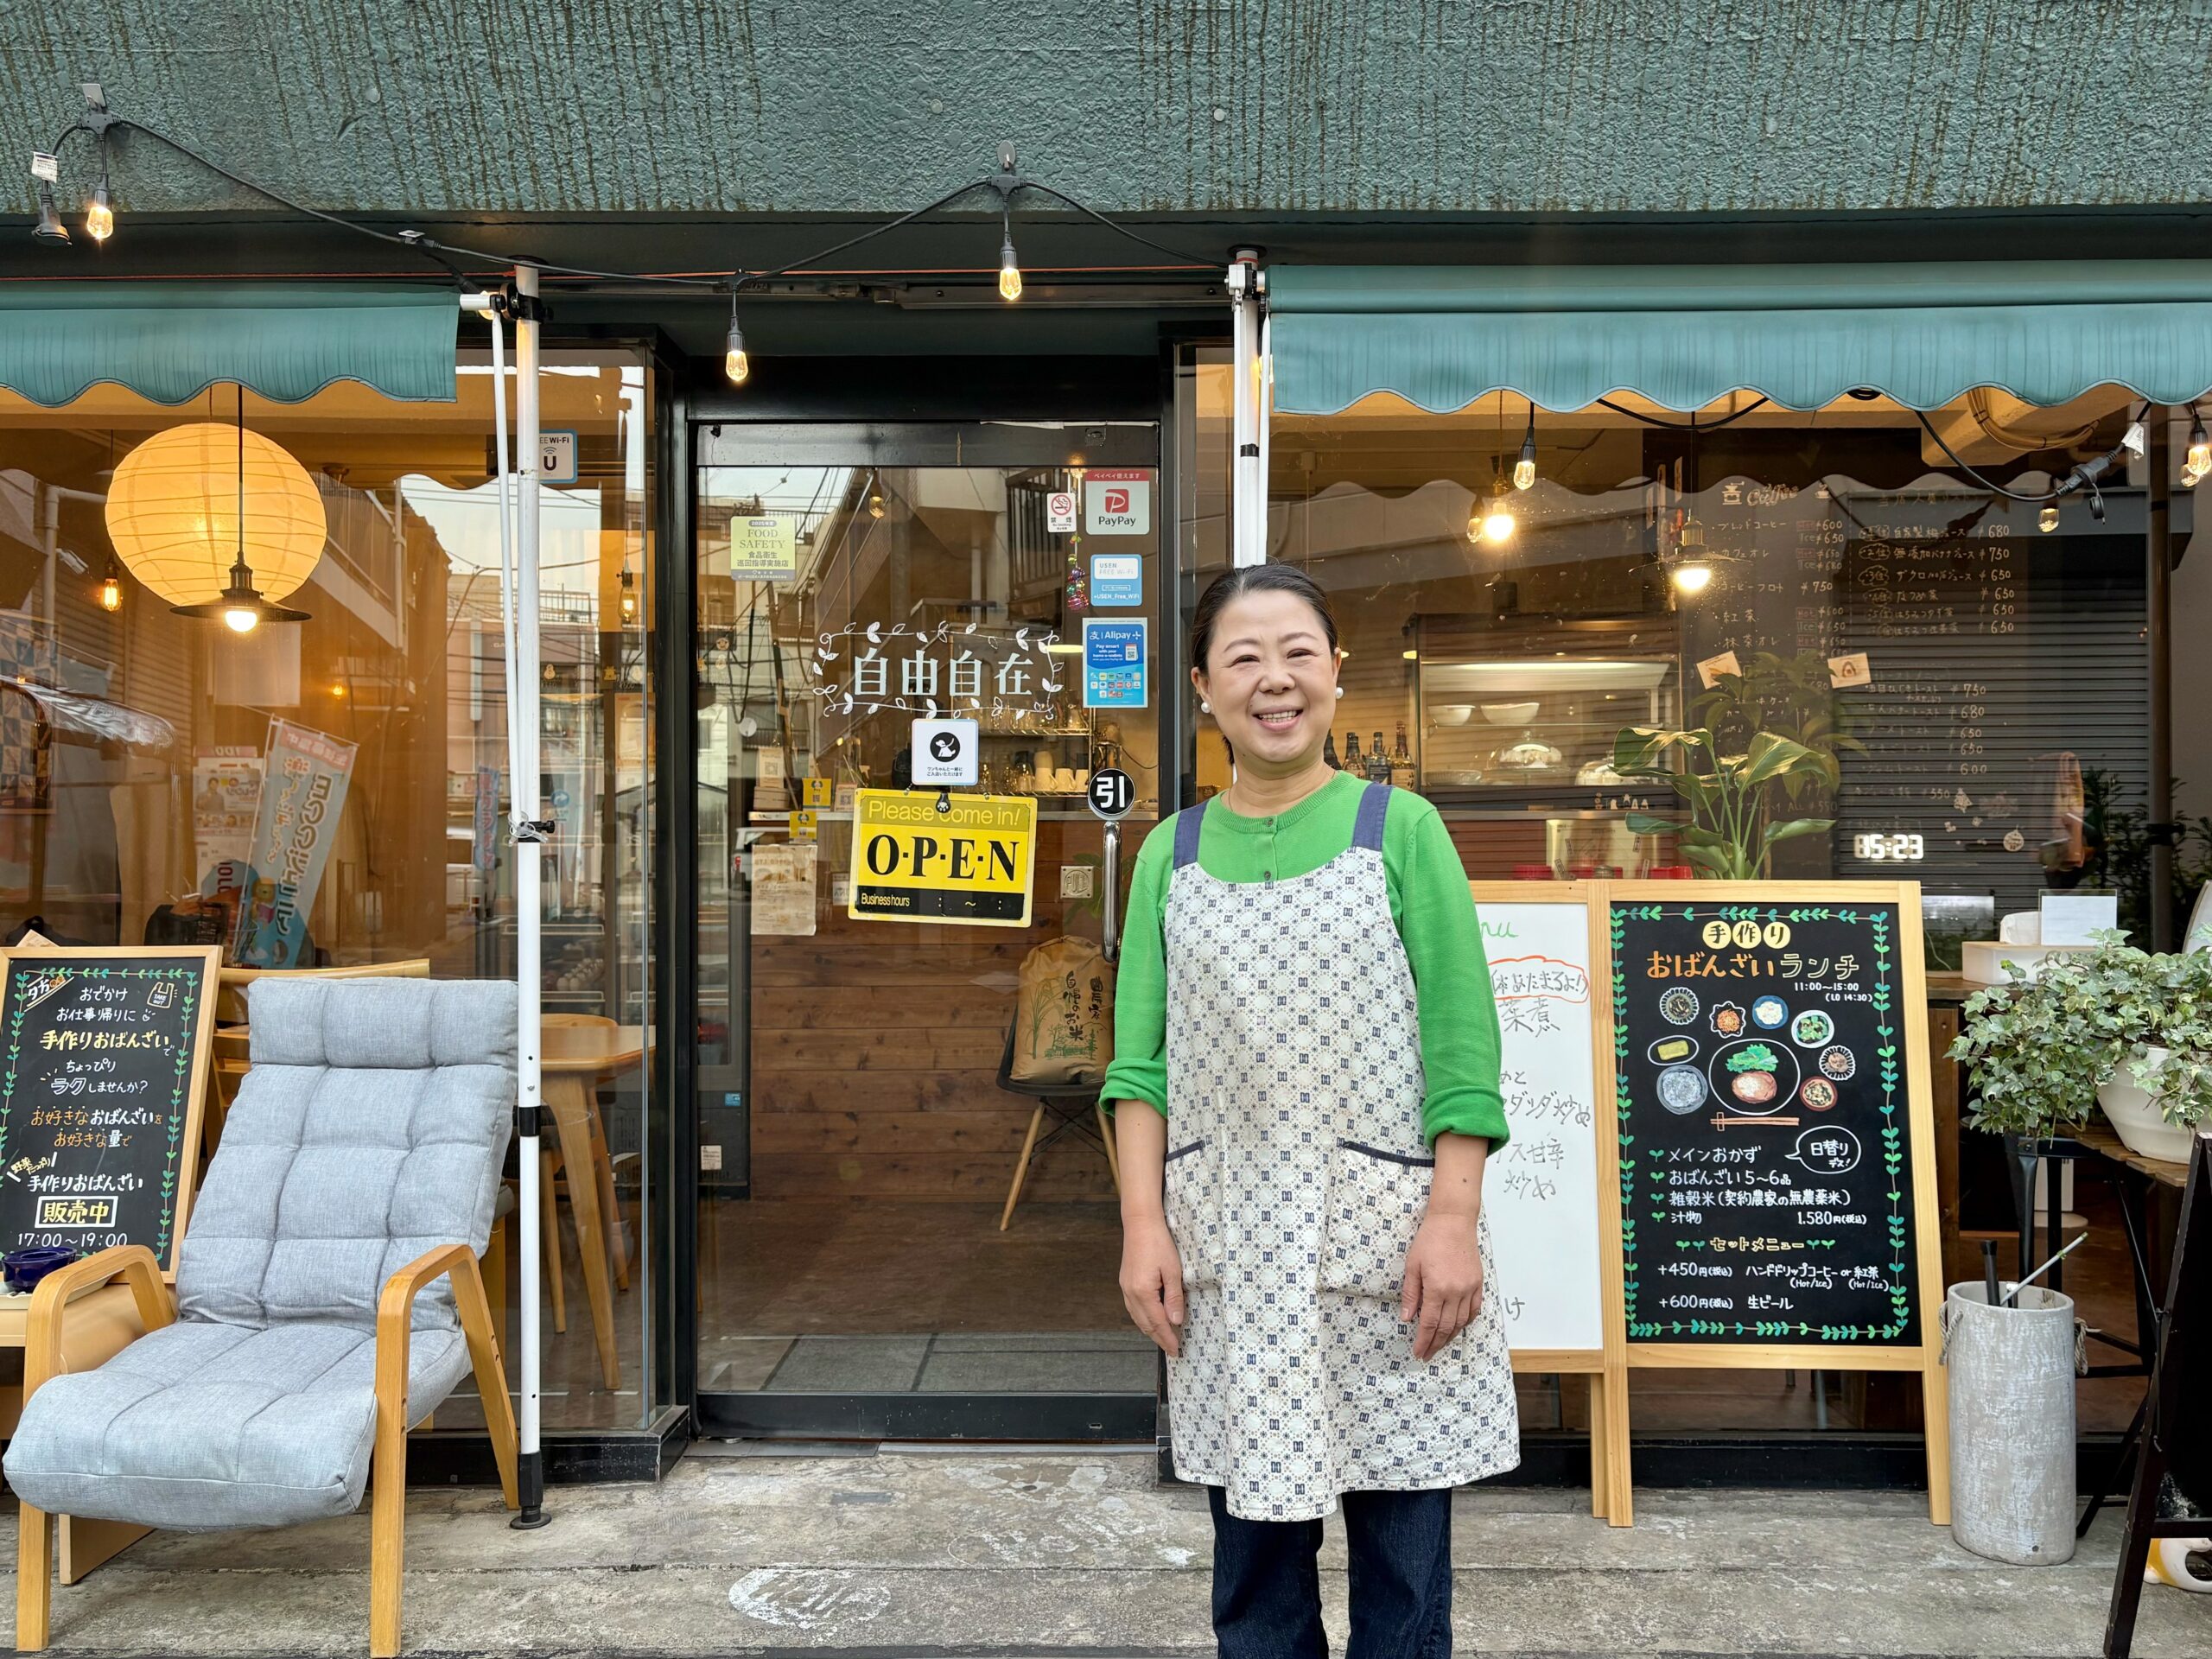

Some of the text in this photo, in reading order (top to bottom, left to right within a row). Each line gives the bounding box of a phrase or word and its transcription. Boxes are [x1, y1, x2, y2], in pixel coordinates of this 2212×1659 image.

[1098, 516, 1136, 527] PayPay
[747, 529, 778, 537] FOOD
[740, 540, 785, 549] SAFETY
[855, 647, 1033, 696] 自由自在
[1096, 776, 1126, 808] 引
[869, 800, 935, 822] Please
[997, 807, 1020, 826] in!
[1862, 834, 1923, 860] 15:23
[861, 893, 890, 906] Business
[890, 894, 910, 907] hours
[1481, 922, 1519, 939] nu
[1707, 924, 1784, 944] 手作り
[1647, 950, 1859, 981] おばんざいランチ
[79, 985, 128, 1001] おでかけ
[154, 993, 167, 1001] TAKE
[56, 1006, 137, 1022] お仕事帰りに
[66, 1058, 117, 1073] ちょっぴり
[54, 1129, 132, 1147] お好きな量で
[1669, 1146, 1762, 1163] メインおかず
[1810, 1139, 1849, 1156] 日替り
[1828, 1157, 1851, 1168] デス!
[28, 1173, 143, 1192] 手作りおばんざい
[42, 1200, 109, 1224] 販売中
[1671, 1211, 1702, 1225] 汁物
[1710, 1236, 1804, 1252] セットメニュー
[1745, 1262, 1838, 1278] ハンドドリップコーヒー
[1854, 1266, 1879, 1279] 紅茶
[1748, 1294, 1794, 1310] 生ビール
